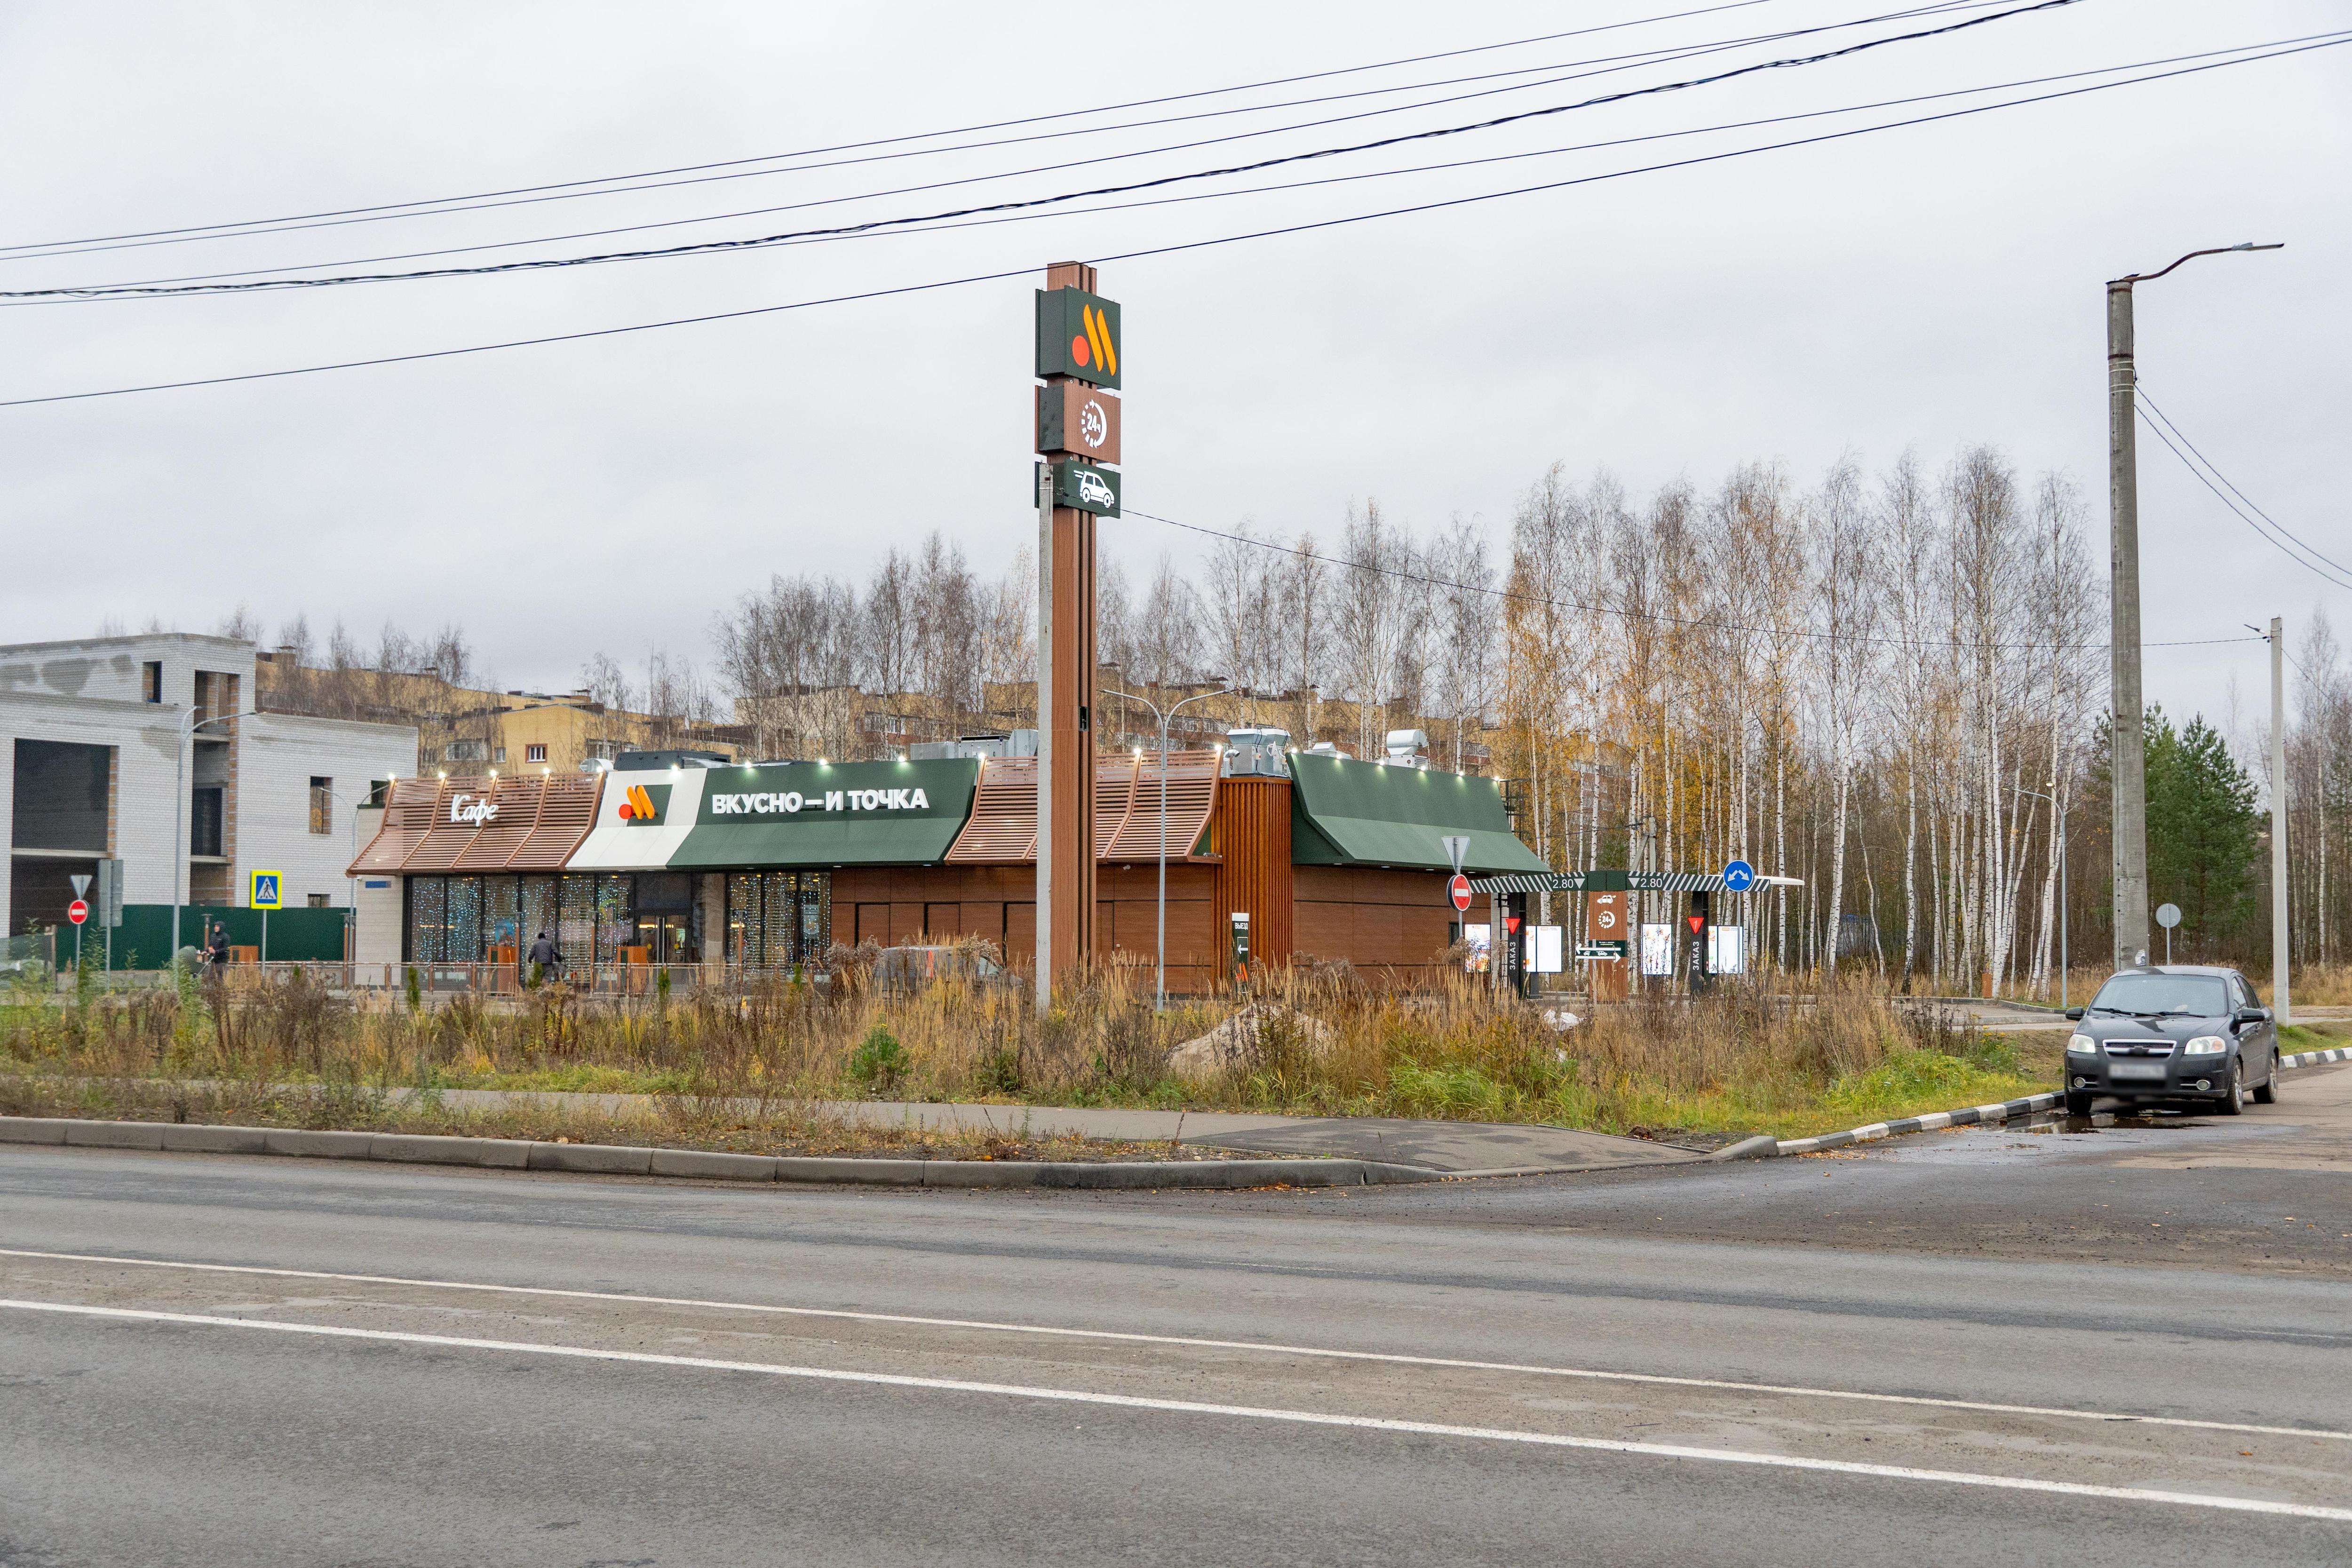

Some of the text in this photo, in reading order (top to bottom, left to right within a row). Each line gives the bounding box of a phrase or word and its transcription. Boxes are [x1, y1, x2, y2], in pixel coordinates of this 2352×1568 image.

[1087, 413, 1101, 433] 24ч
[712, 792, 803, 814] ВКУСНО
[826, 791, 843, 811] И
[847, 788, 930, 811] ТОЧКА
[451, 794, 499, 827] Кафе
[1552, 879, 1573, 888] 2.80
[1640, 878, 1662, 888] 2.80
[1510, 921, 1515, 930] 1
[1693, 920, 1698, 929] 1
